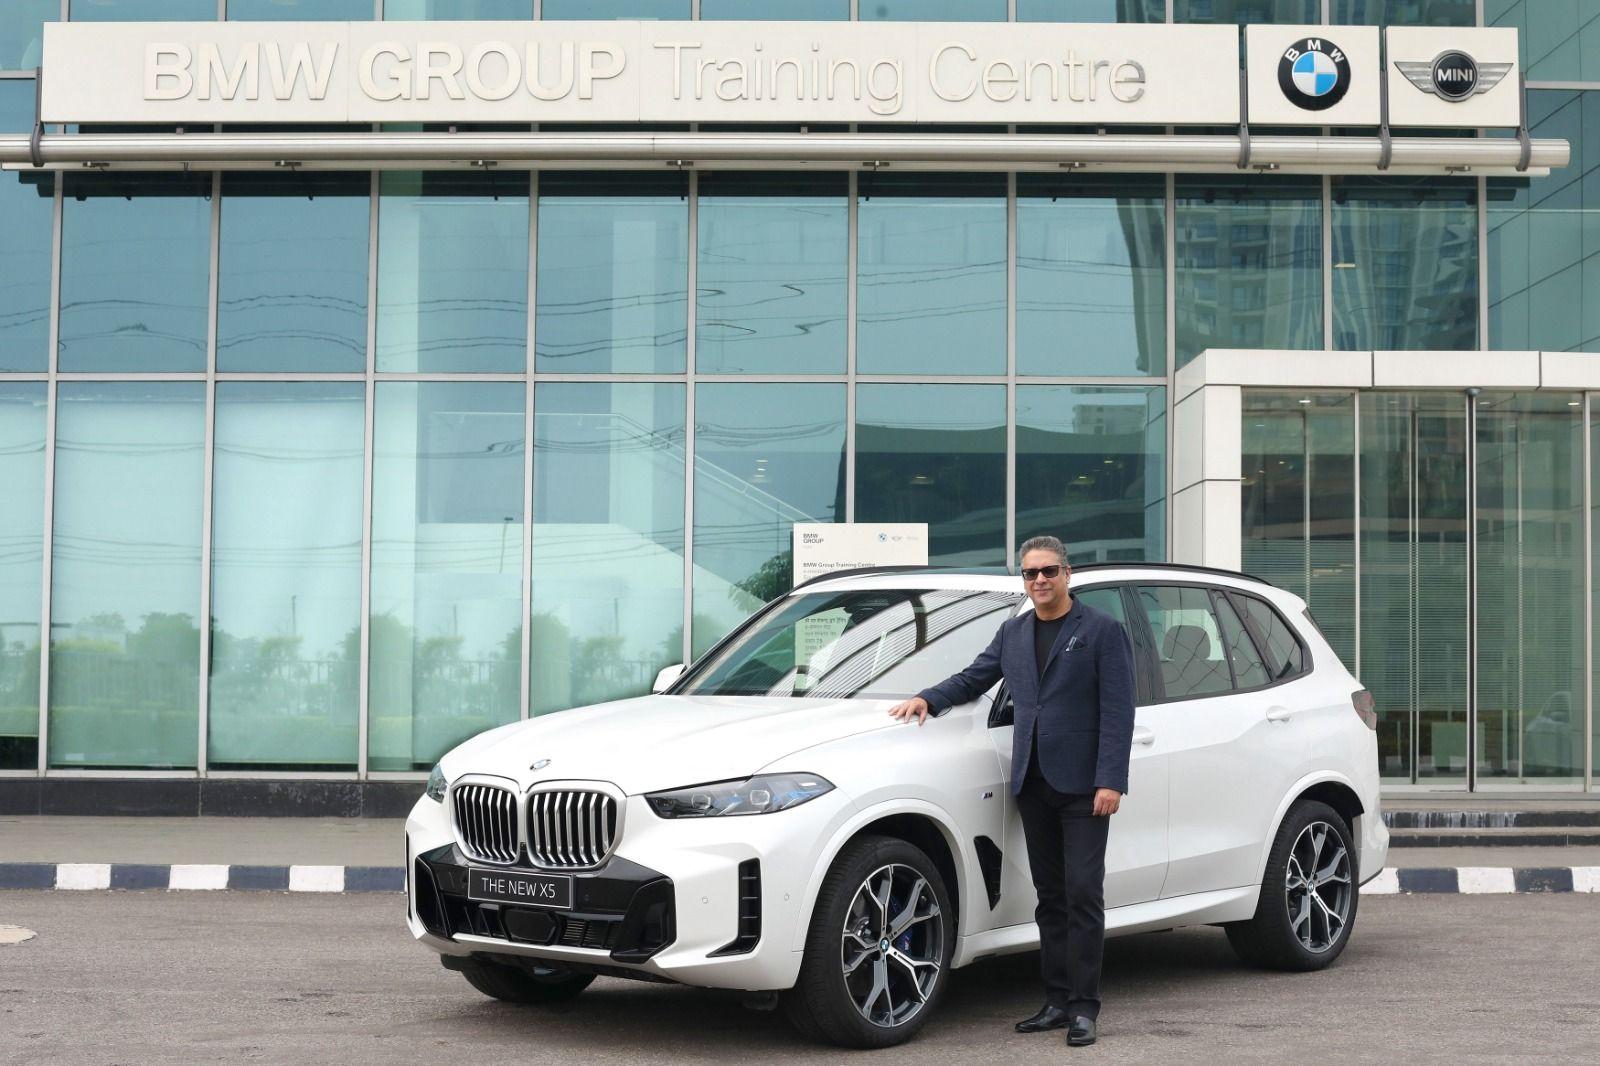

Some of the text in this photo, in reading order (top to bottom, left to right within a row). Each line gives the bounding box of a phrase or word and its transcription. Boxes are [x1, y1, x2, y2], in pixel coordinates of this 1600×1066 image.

[1284, 39, 1345, 63] BMW
[143, 40, 1146, 116] BMW GROUP Training Centre
[1437, 68, 1473, 81] MINI
[481, 877, 556, 899] THE NEW X5
